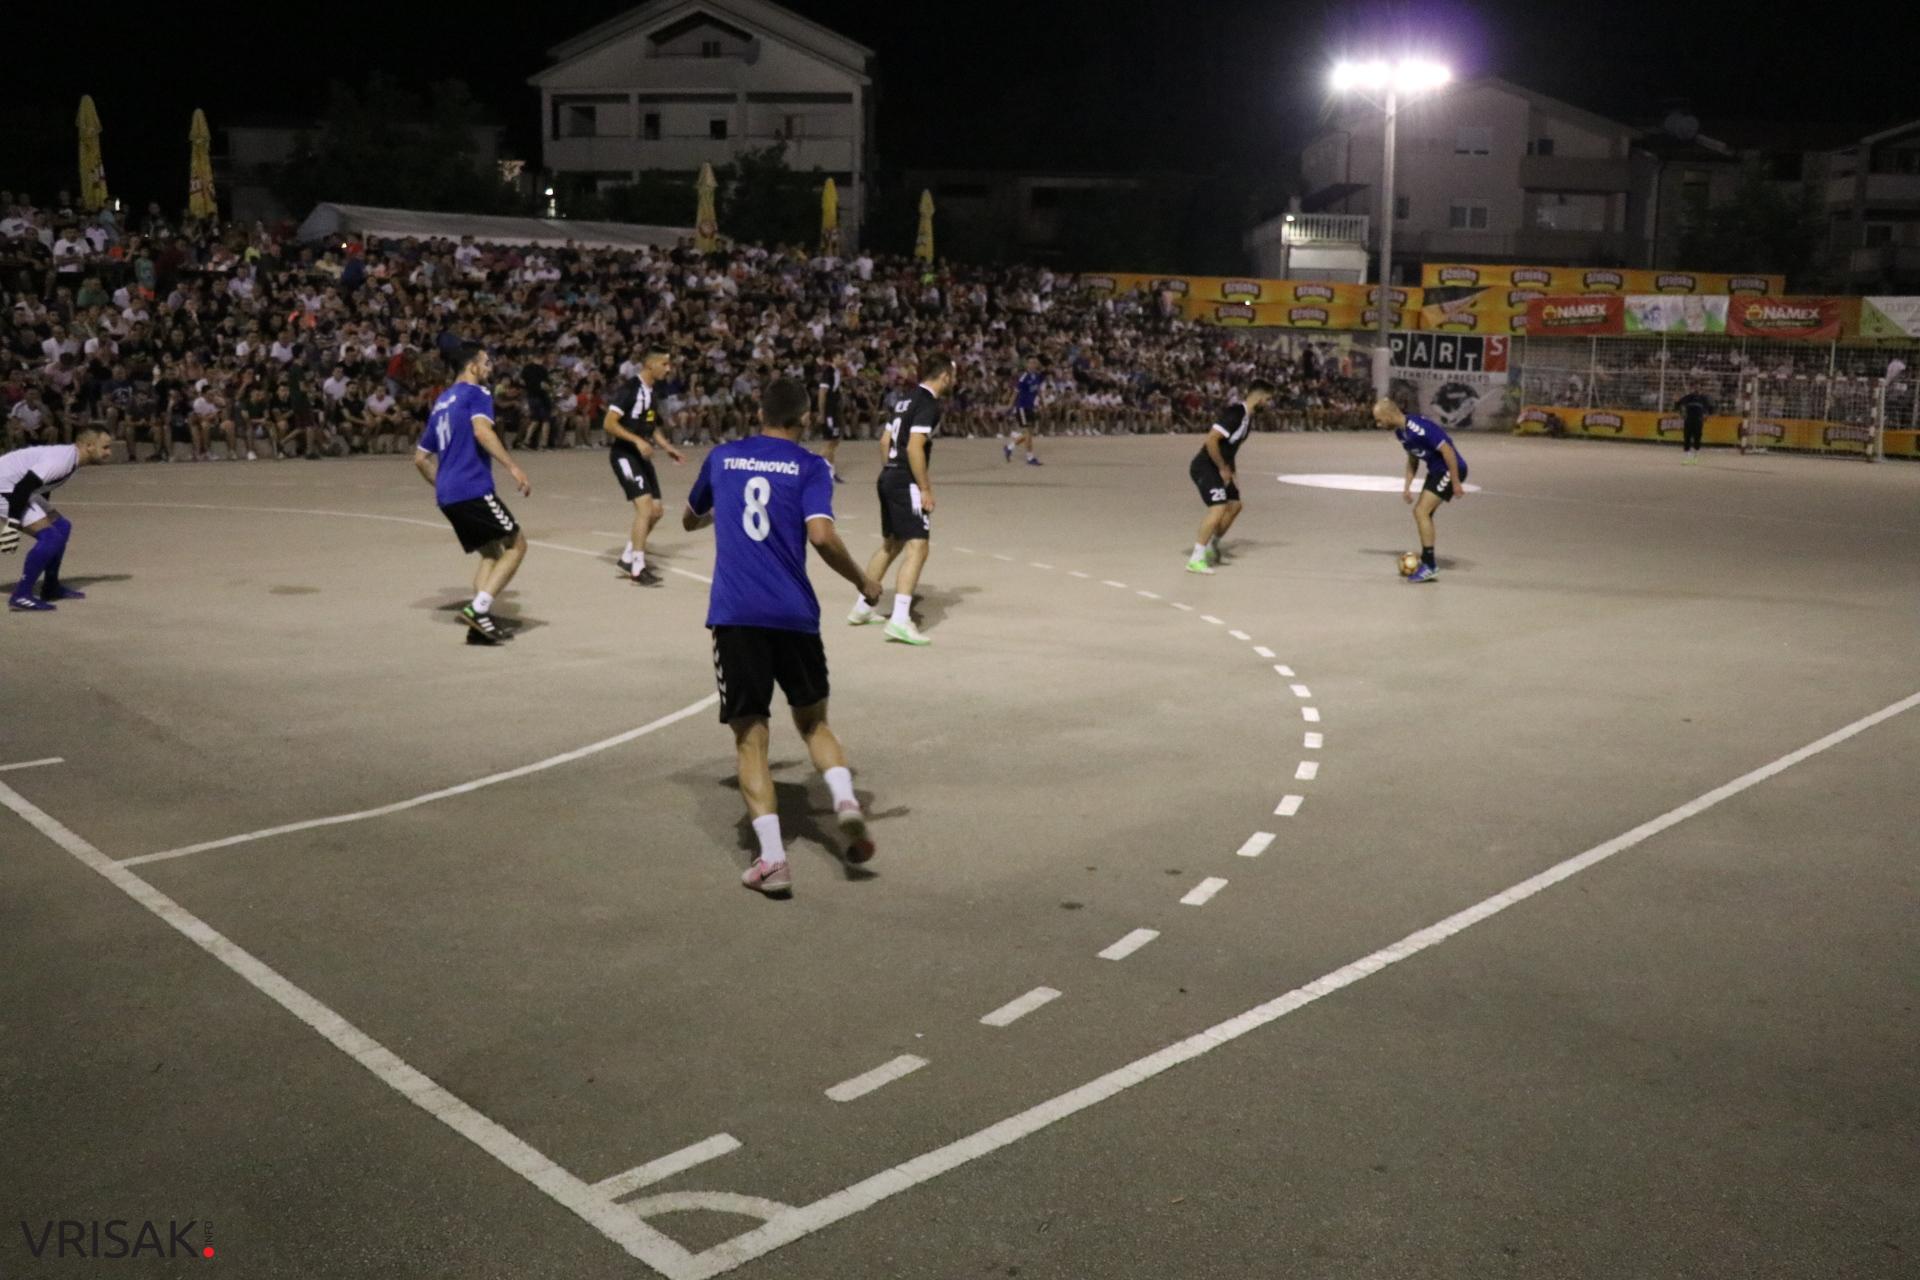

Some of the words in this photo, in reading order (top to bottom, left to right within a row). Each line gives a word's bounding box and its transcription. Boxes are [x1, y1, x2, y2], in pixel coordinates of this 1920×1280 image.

[1558, 304, 1606, 318] NAMEX
[1764, 306, 1820, 320] NAMEX
[1389, 335, 1503, 372] PARTS
[635, 475, 644, 490] 7
[742, 476, 771, 541] 8
